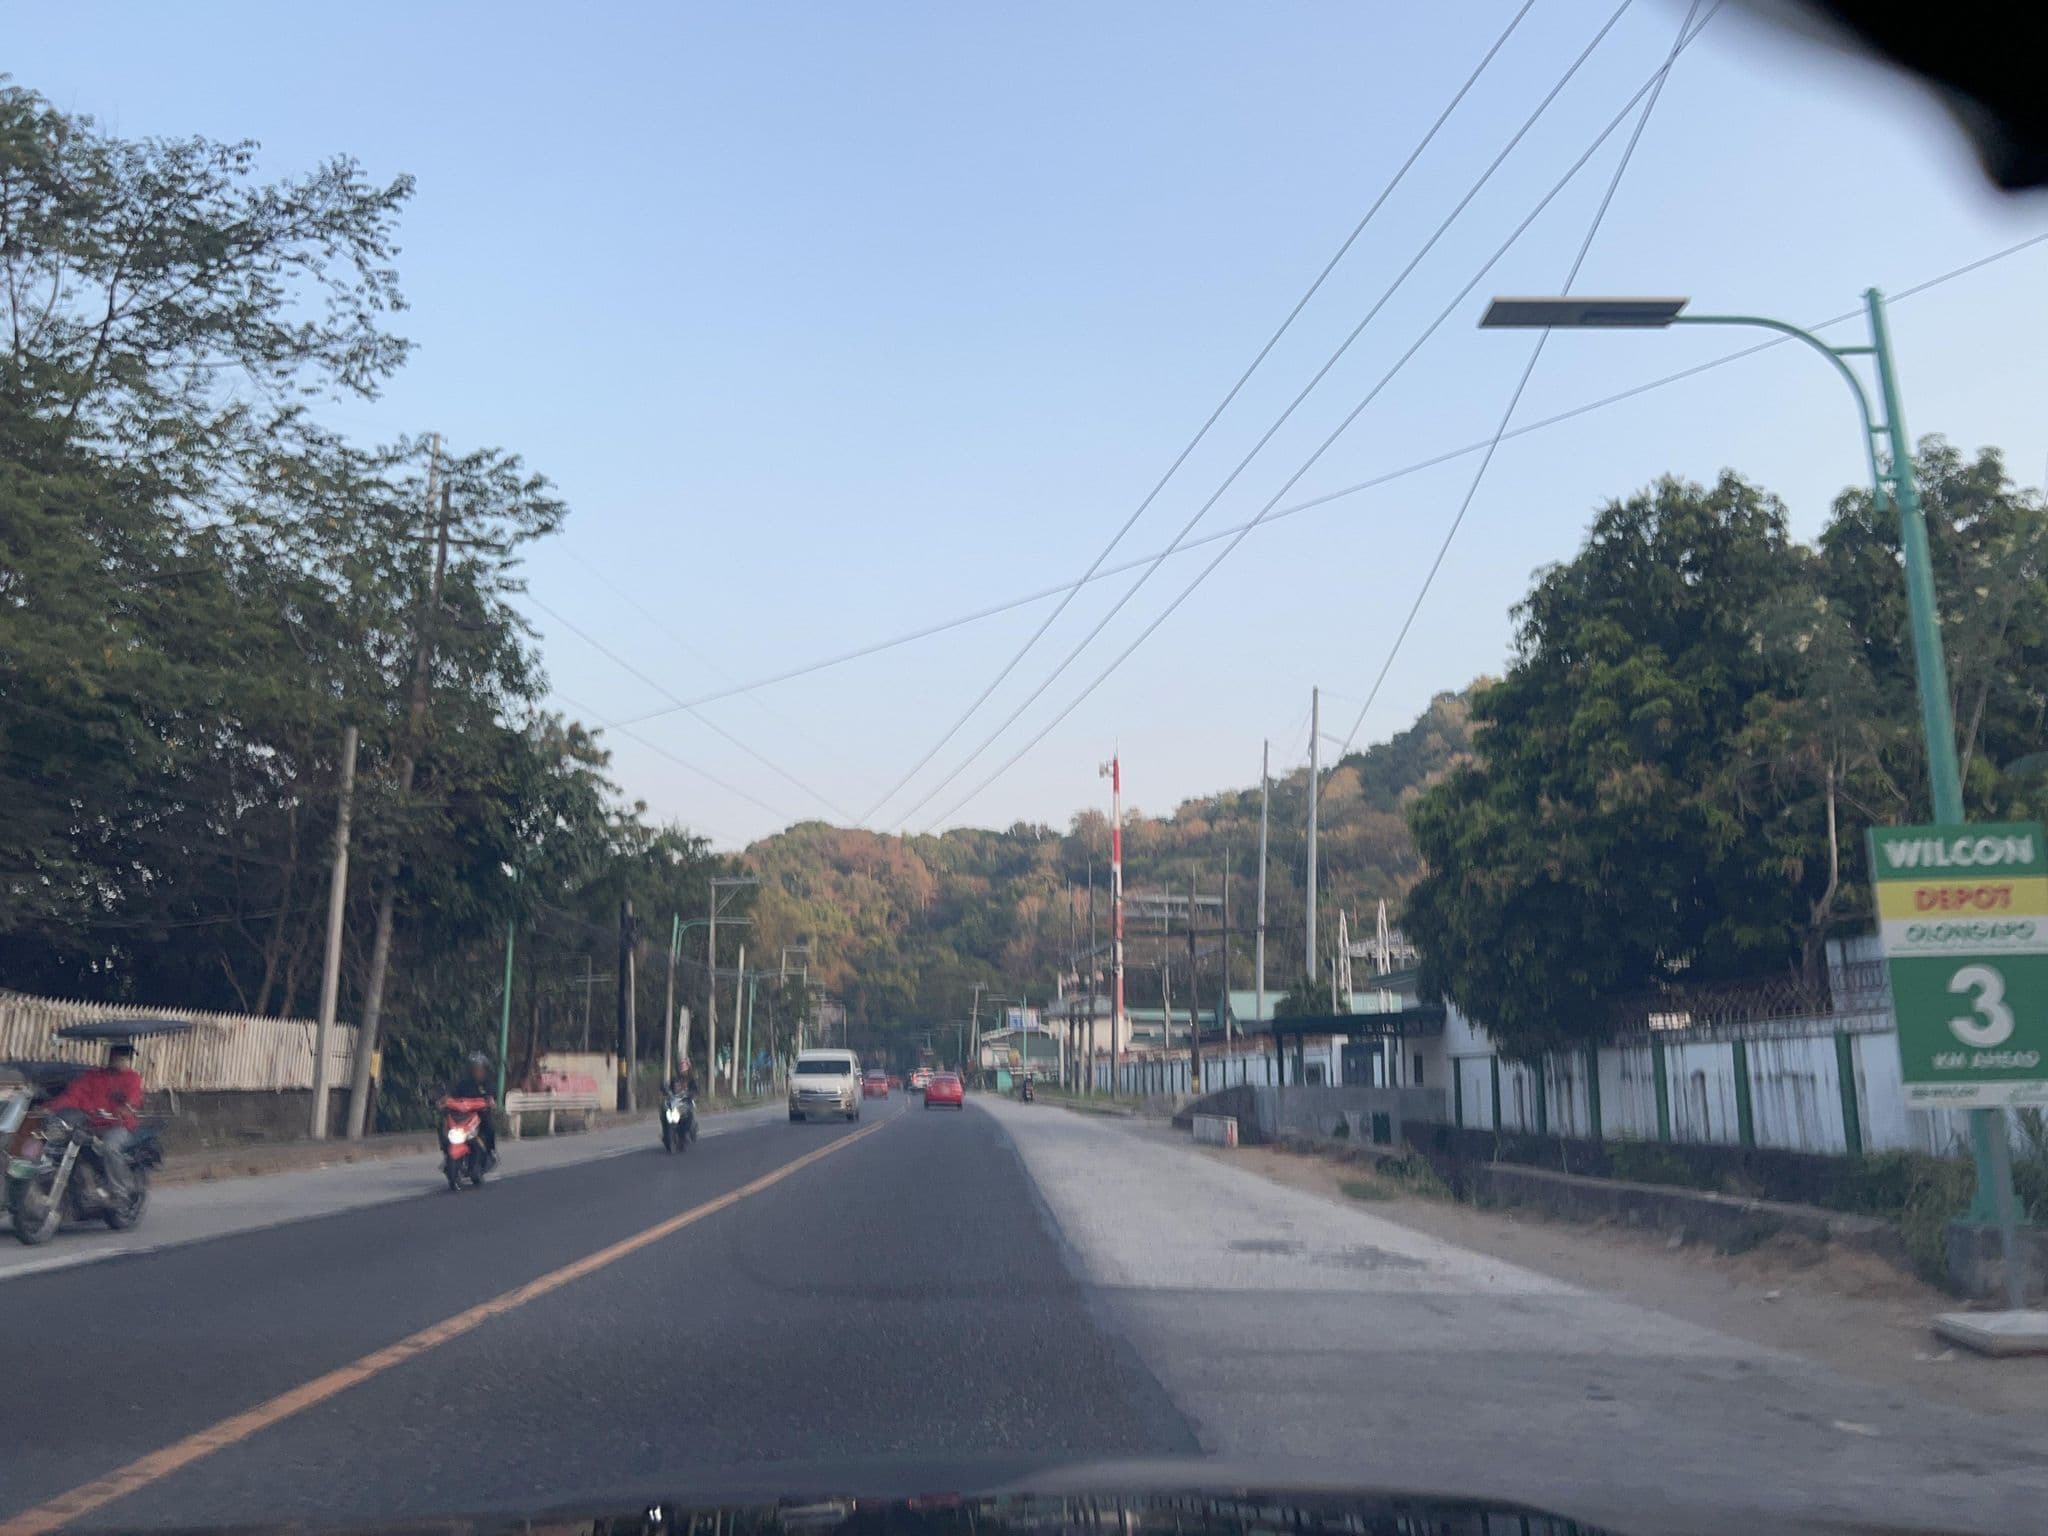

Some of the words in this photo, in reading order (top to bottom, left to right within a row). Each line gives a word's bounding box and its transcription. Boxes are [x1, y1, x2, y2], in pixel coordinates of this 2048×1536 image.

[1884, 835, 2034, 868] WILCON
[1915, 885, 2013, 912] DEPOT
[1948, 963, 2014, 1048] 3
